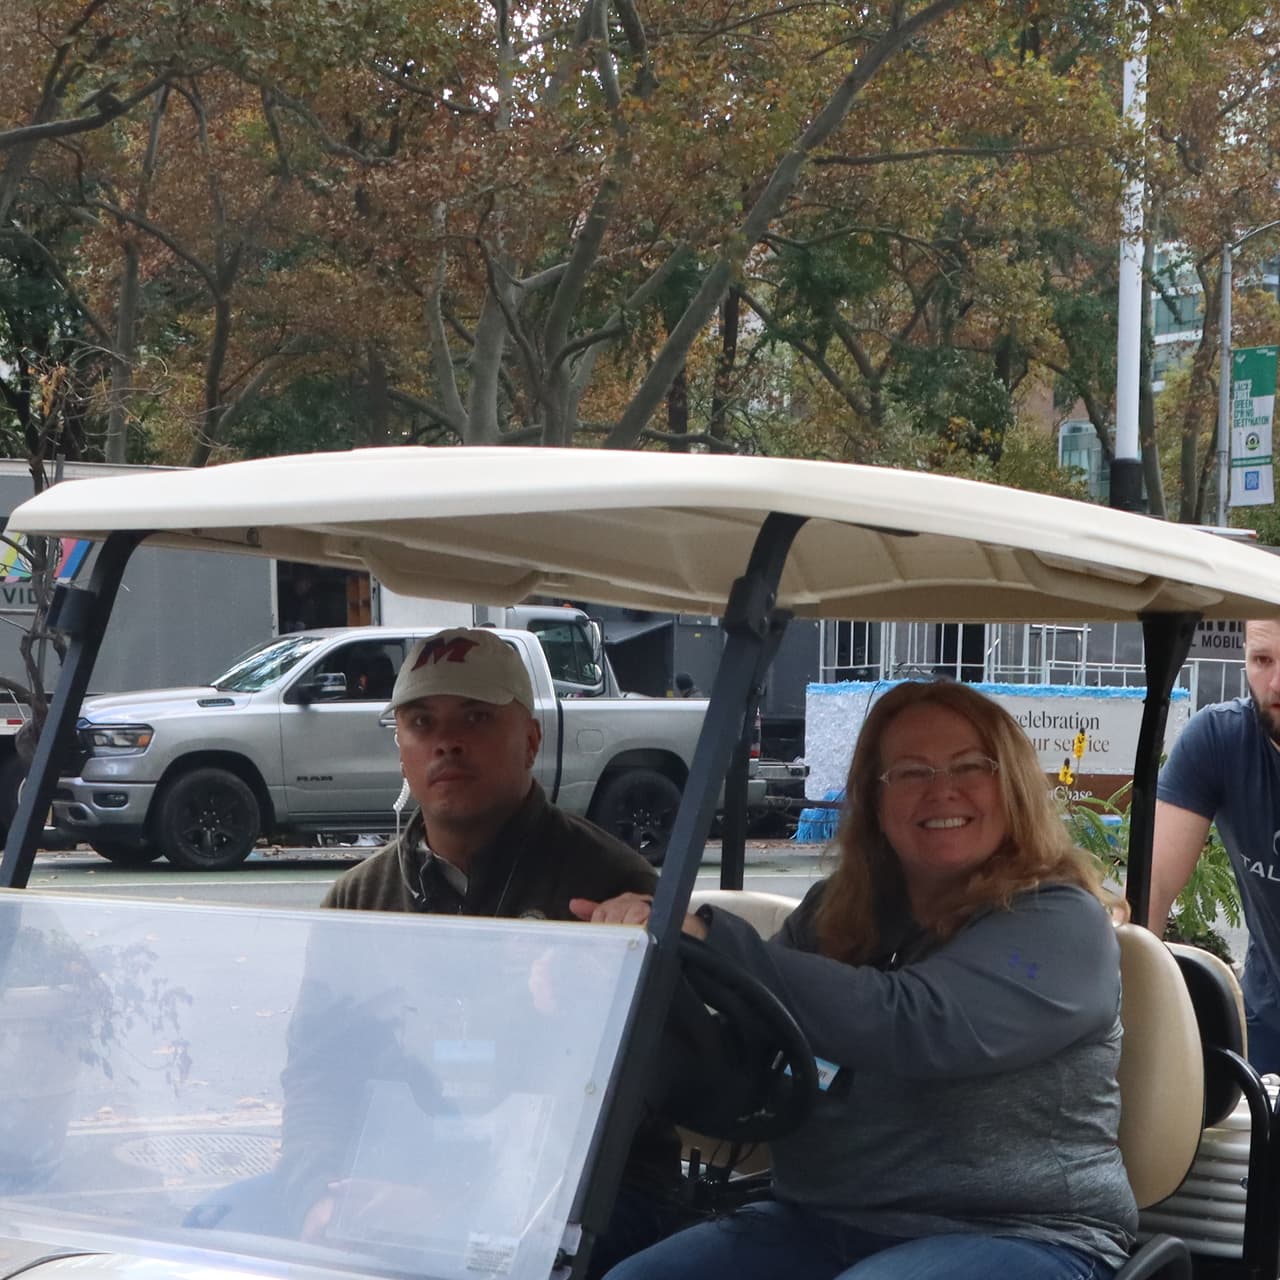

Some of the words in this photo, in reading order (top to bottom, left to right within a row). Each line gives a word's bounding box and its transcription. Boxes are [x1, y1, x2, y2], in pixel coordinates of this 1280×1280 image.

[1201, 635, 1243, 648] MOBIL
[1015, 710, 1100, 730] elebration
[1054, 735, 1110, 753] serice
